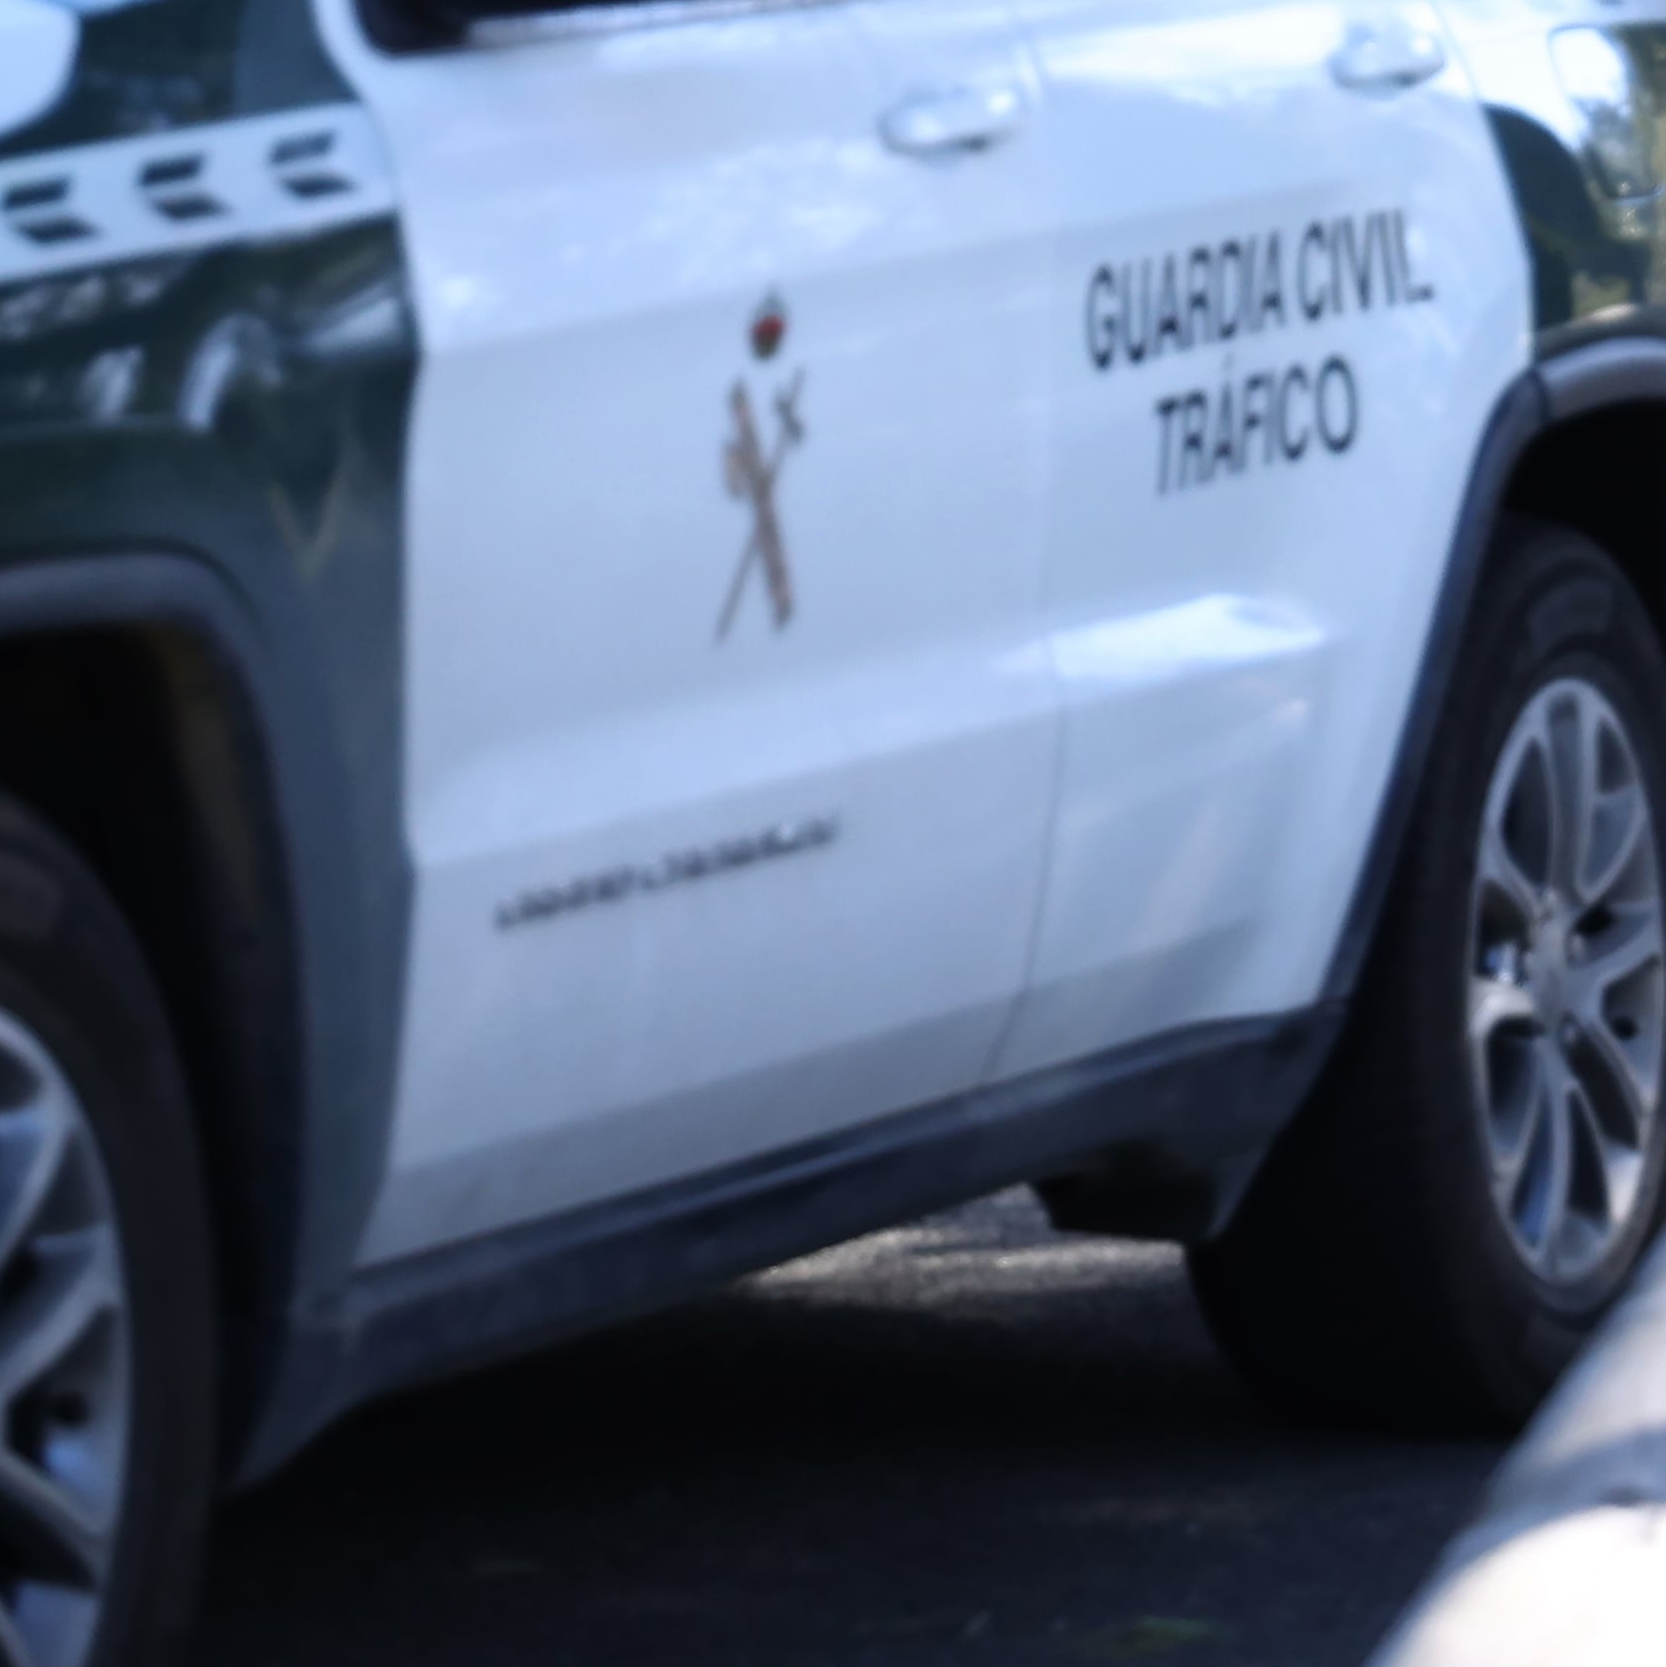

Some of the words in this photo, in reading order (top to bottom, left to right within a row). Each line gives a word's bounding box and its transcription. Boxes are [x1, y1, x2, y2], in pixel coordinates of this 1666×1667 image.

[1085, 227, 1287, 371] GUARDIA
[1295, 208, 1436, 322] CIVIL
[1154, 350, 1360, 496] TRÁFICO
